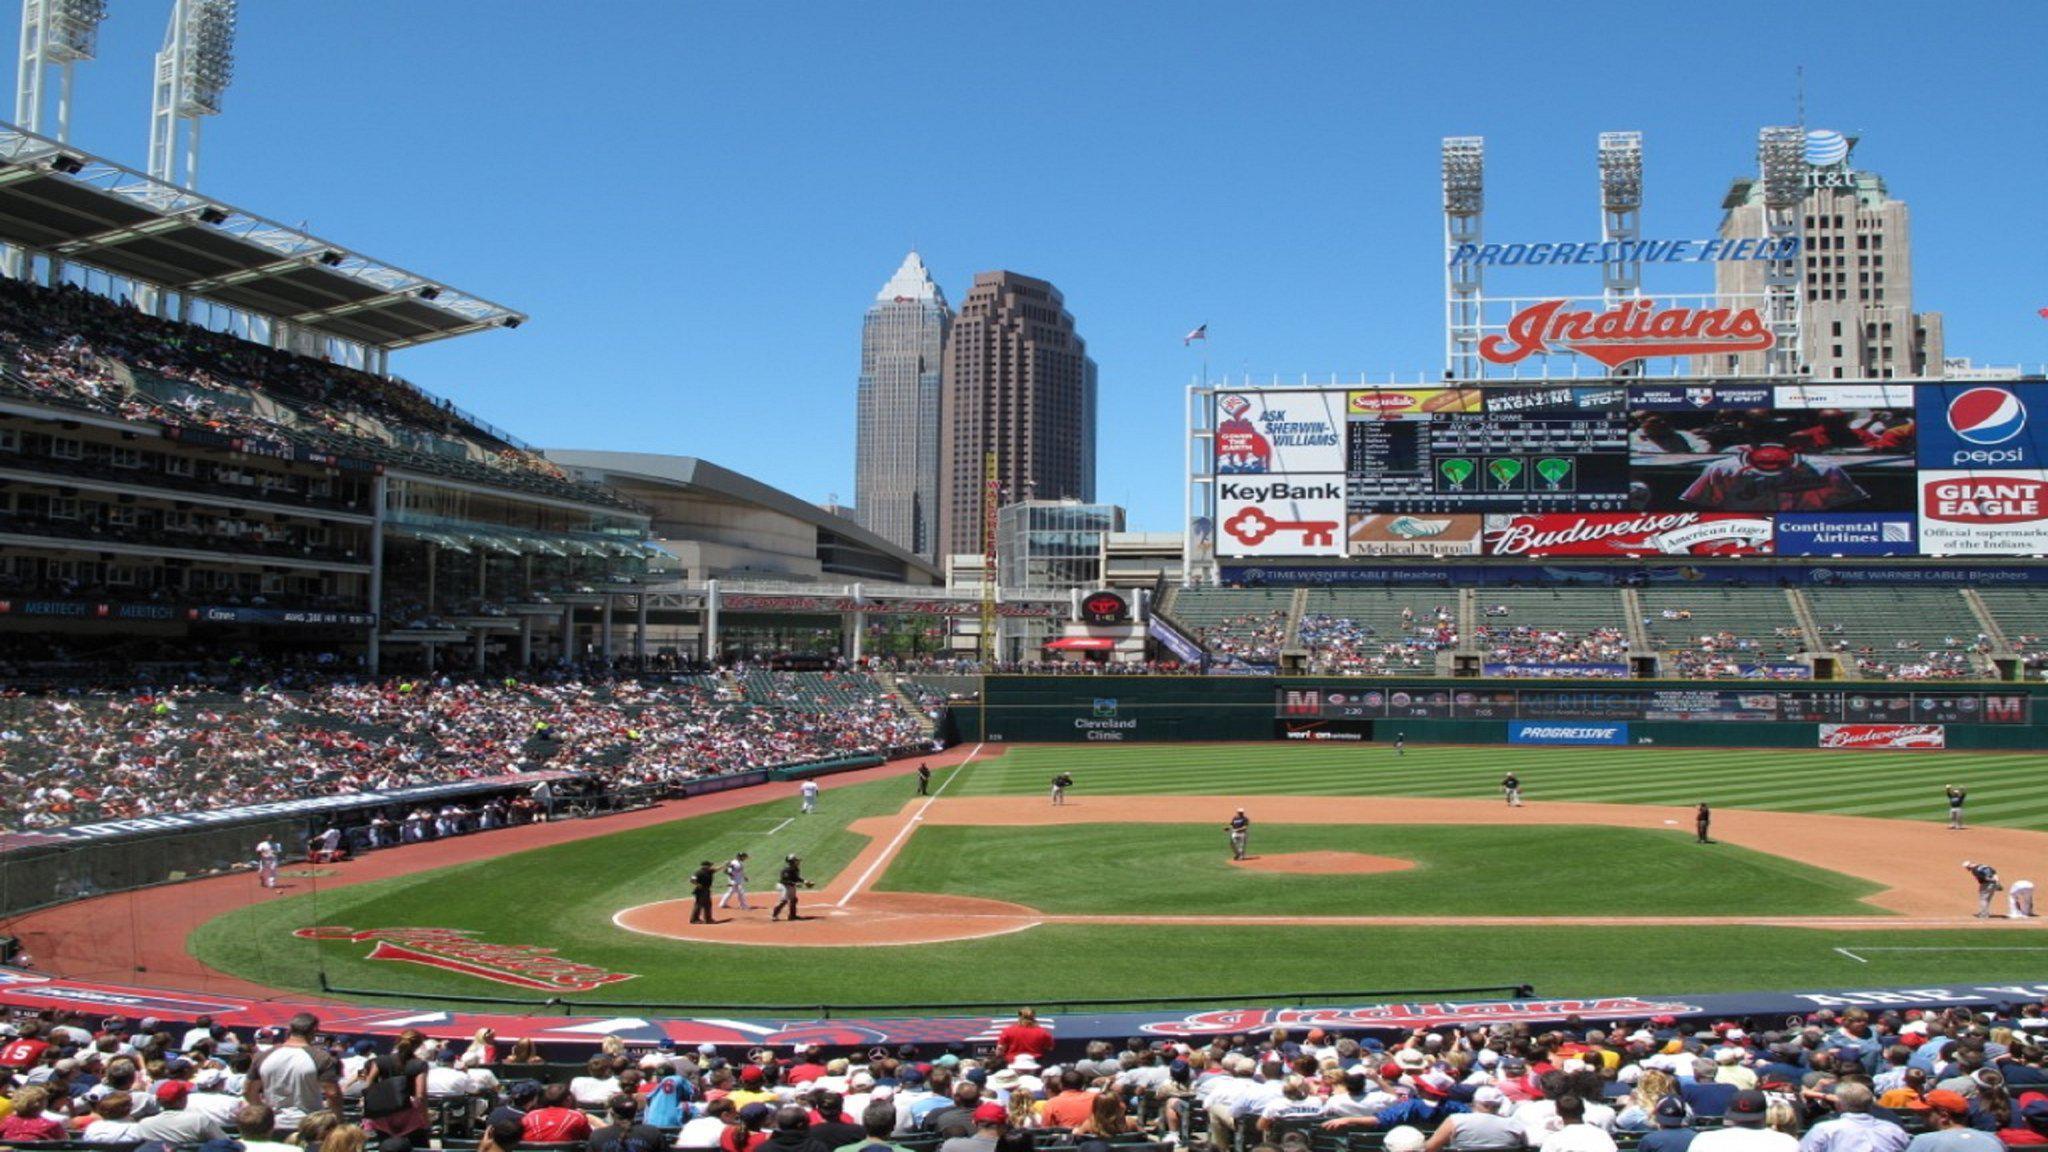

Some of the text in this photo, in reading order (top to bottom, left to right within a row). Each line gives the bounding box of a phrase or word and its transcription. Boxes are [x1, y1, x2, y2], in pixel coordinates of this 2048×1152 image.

[1450, 237, 1801, 267] PROGRESSIVE FIELD
[1480, 299, 1776, 367] Indians
[1258, 410, 1286, 422] ASK
[1264, 422, 1330, 435] SHERWIN-
[1273, 434, 1338, 447] WILLIAMS
[1953, 446, 2023, 466] pepsi
[1221, 482, 1341, 503] KeyBank
[1936, 484, 2041, 500] GIANT
[1938, 500, 2040, 516] EAGLE
[1490, 511, 1699, 555] Budweiser
[1779, 522, 1879, 532] Continental
[1924, 528, 1971, 538] Official
[1667, 523, 1768, 546] American Lager
[1813, 532, 1879, 542] Airlines
[1358, 543, 1473, 554] Medical Mutual
[1944, 540, 1958, 549] of
[1960, 540, 1979, 549] the
[1266, 570, 1294, 580] TIME
[1295, 570, 1348, 581] WARNER
[1350, 570, 1386, 581] CABLE
[1835, 570, 2029, 580] TIME WARNER CABLE Bleachers
[25, 602, 85, 615] MERITECH
[120, 605, 174, 618] MERITECH
[1075, 718, 1137, 728] Cleveland
[1087, 730, 1123, 740] Clinic
[1520, 726, 1618, 739] PROGRESSIVE
[1829, 724, 1929, 746] Budweiser
[1140, 997, 1704, 1036] Indians
